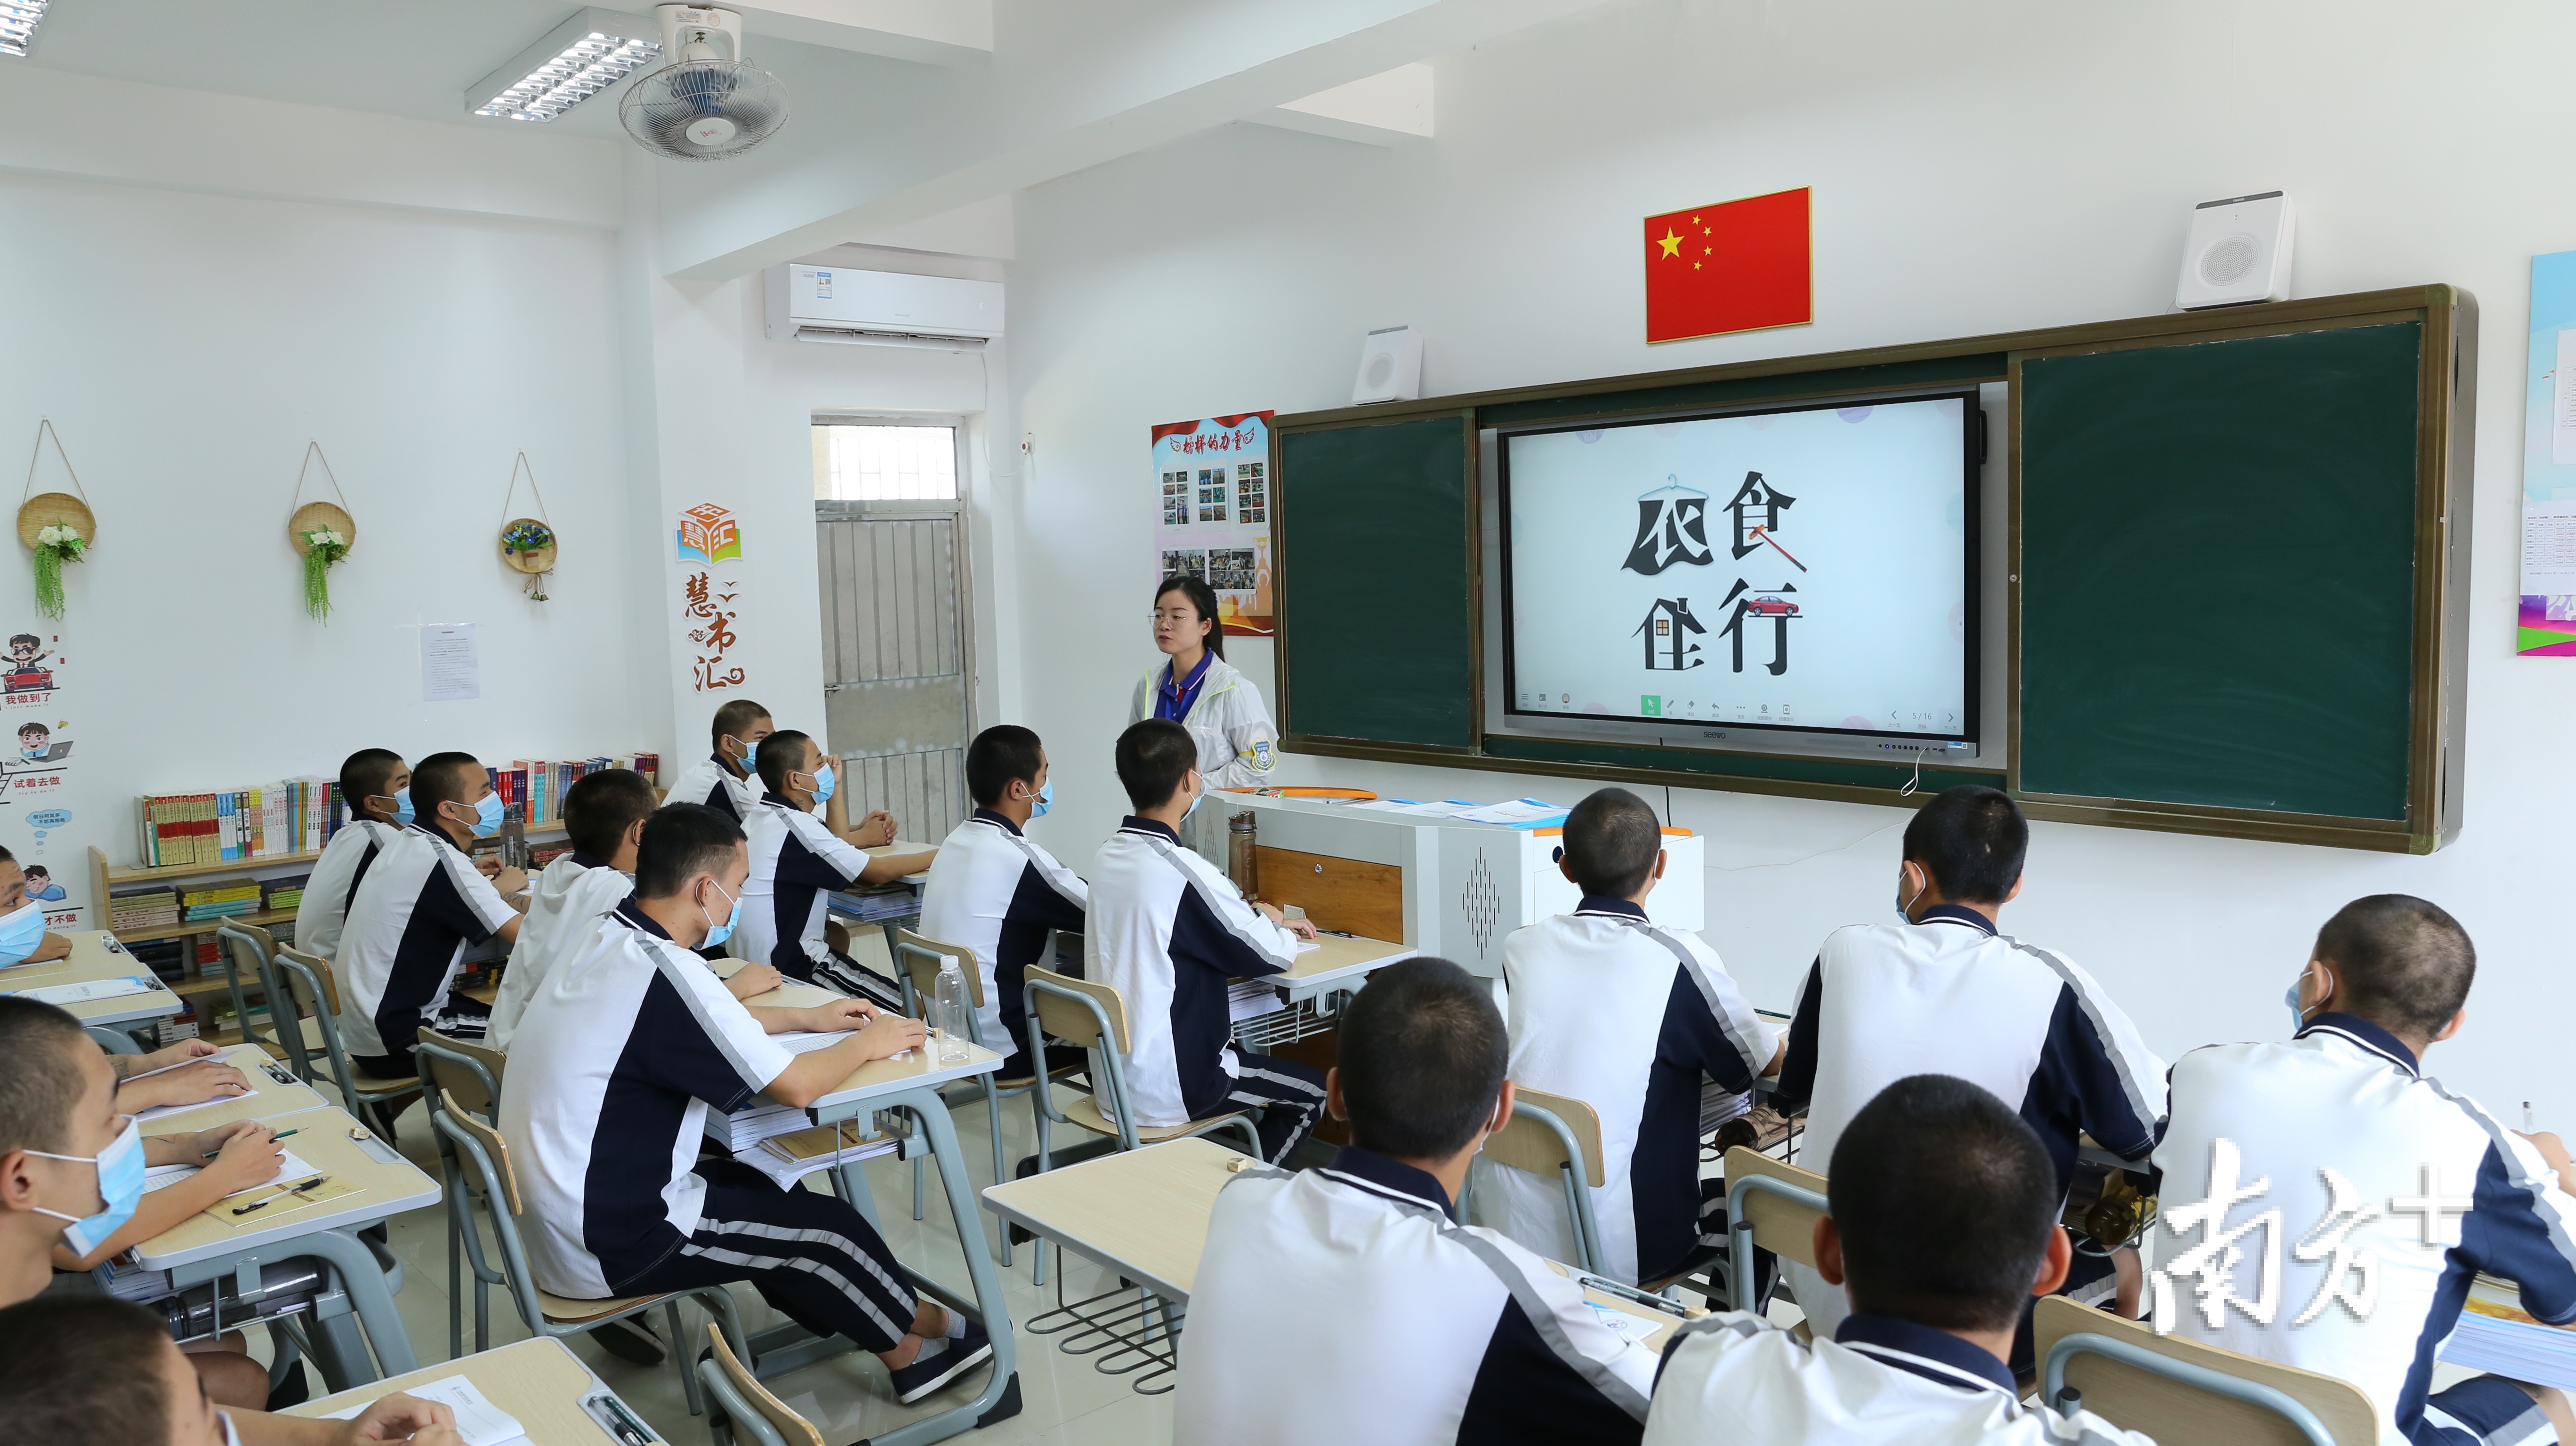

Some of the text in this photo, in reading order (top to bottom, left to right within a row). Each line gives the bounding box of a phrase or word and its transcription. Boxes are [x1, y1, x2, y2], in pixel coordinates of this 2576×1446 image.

[1183, 429, 1243, 455] 榜样的力量
[685, 572, 737, 692] 慧书汇
[1630, 578, 1803, 676] 住行
[5, 692, 51, 705] 我做到了
[14, 776, 61, 788] 试着去做
[44, 913, 77, 925] 才不做
